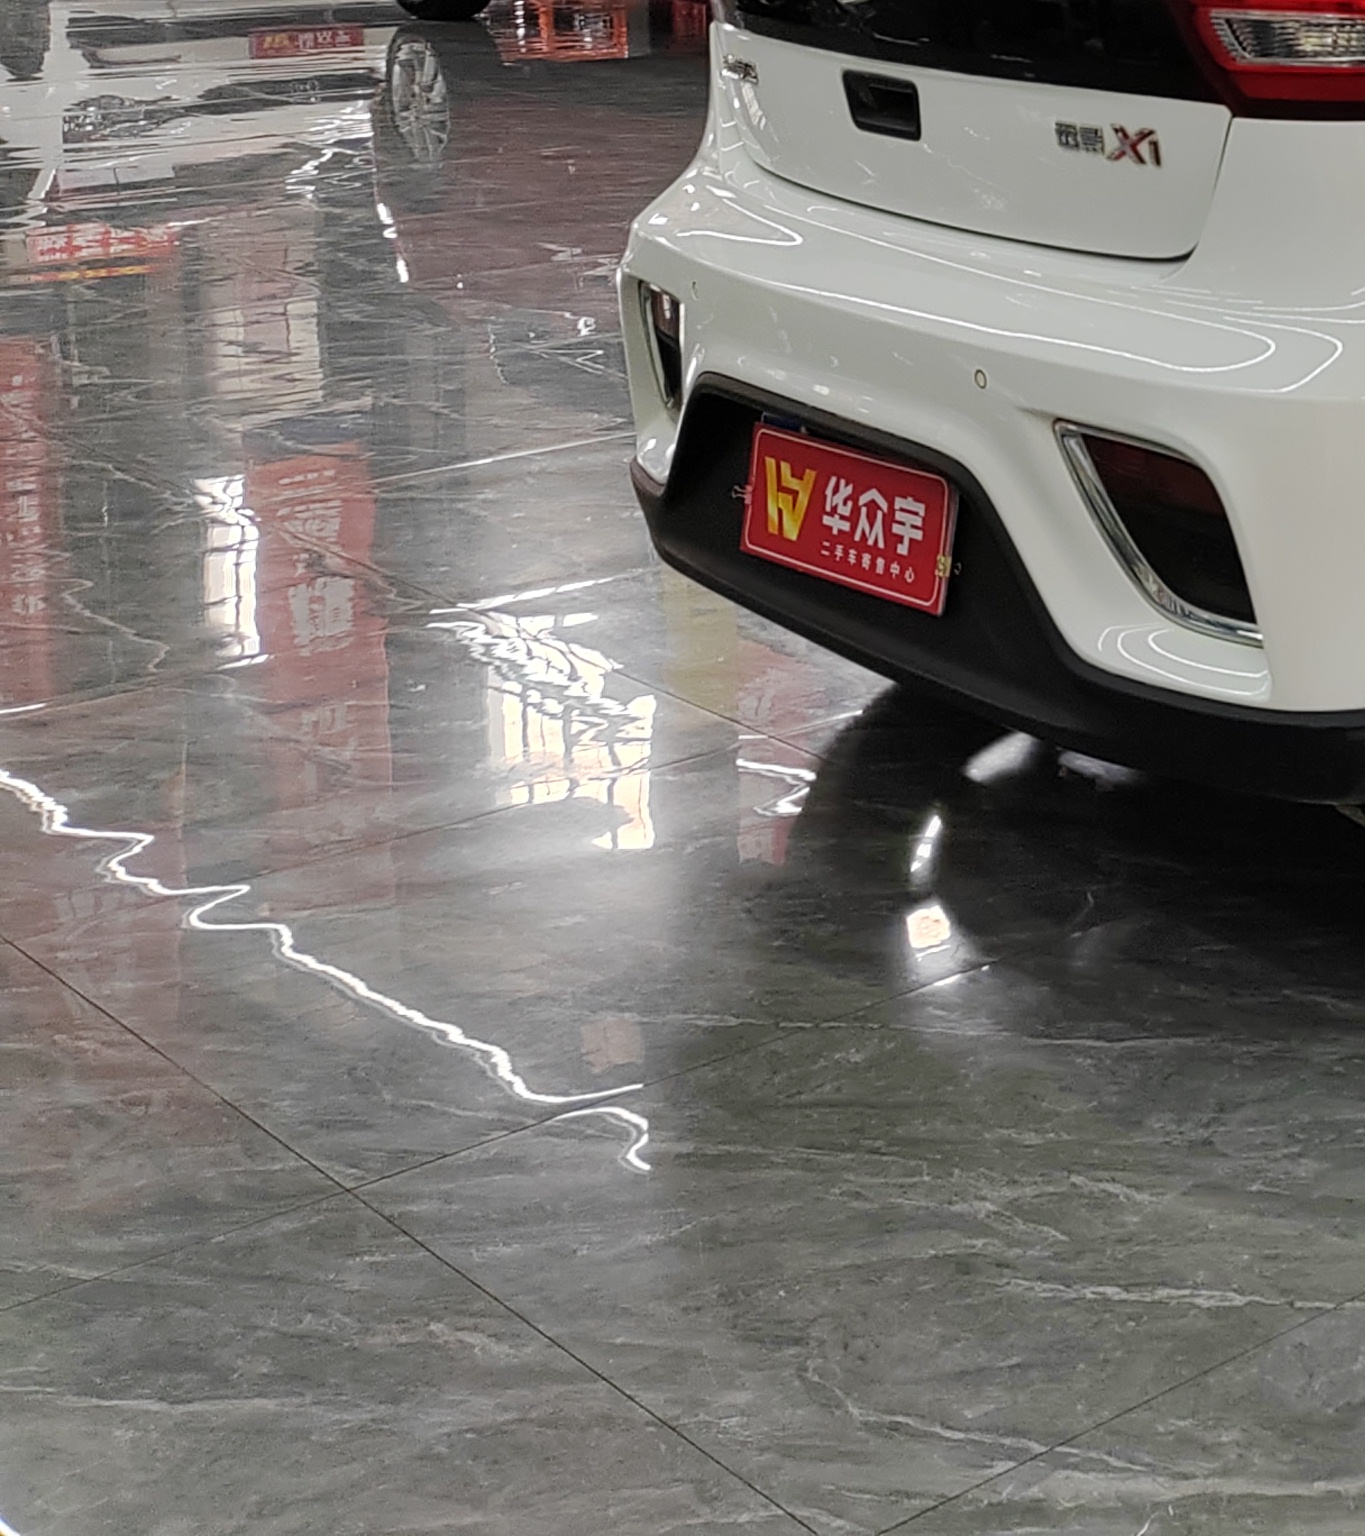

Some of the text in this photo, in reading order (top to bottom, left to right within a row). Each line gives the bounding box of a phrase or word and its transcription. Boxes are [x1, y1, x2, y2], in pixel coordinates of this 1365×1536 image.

[1106, 123, 1162, 167] X1
[822, 475, 927, 556] 华众宇
